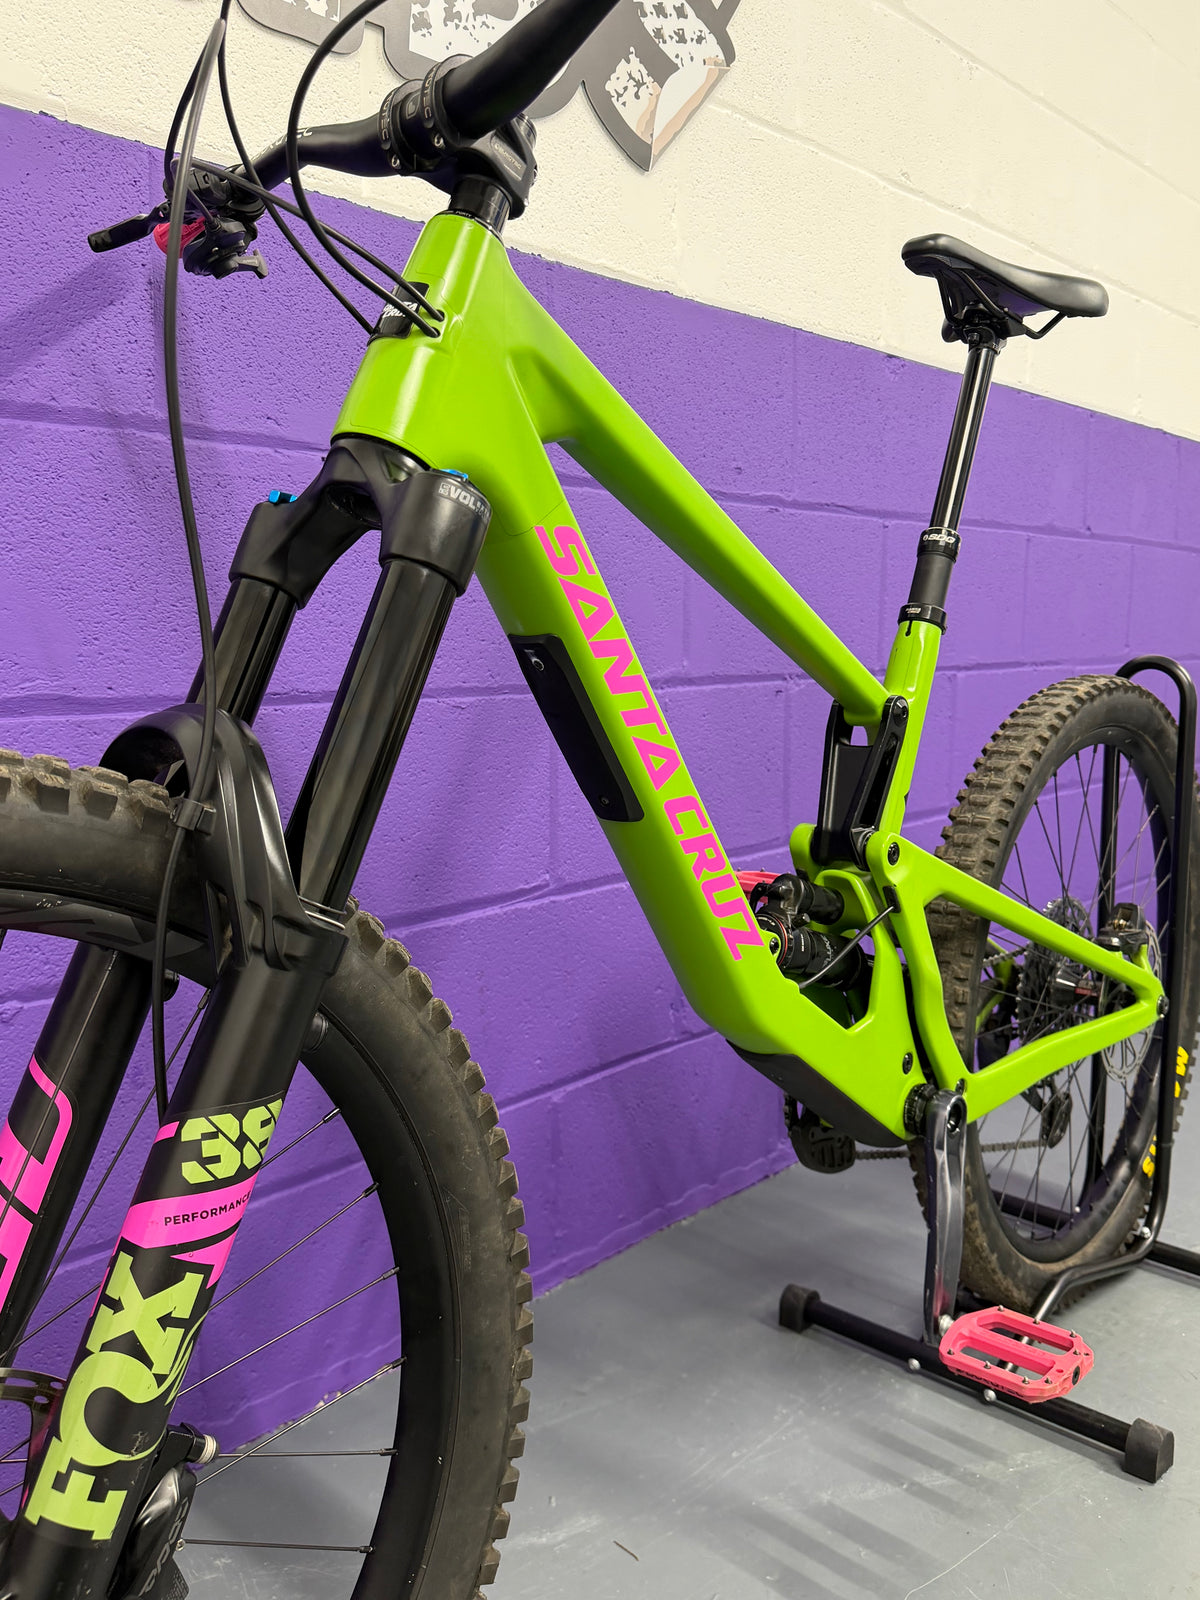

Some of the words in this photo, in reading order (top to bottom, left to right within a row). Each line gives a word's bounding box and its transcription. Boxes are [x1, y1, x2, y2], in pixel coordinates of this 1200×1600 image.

[534, 525, 681, 792] SANTA
[663, 795, 765, 961] CRUZ
[180, 1098, 283, 1185] 38
[24, 1250, 208, 1541] FOX
